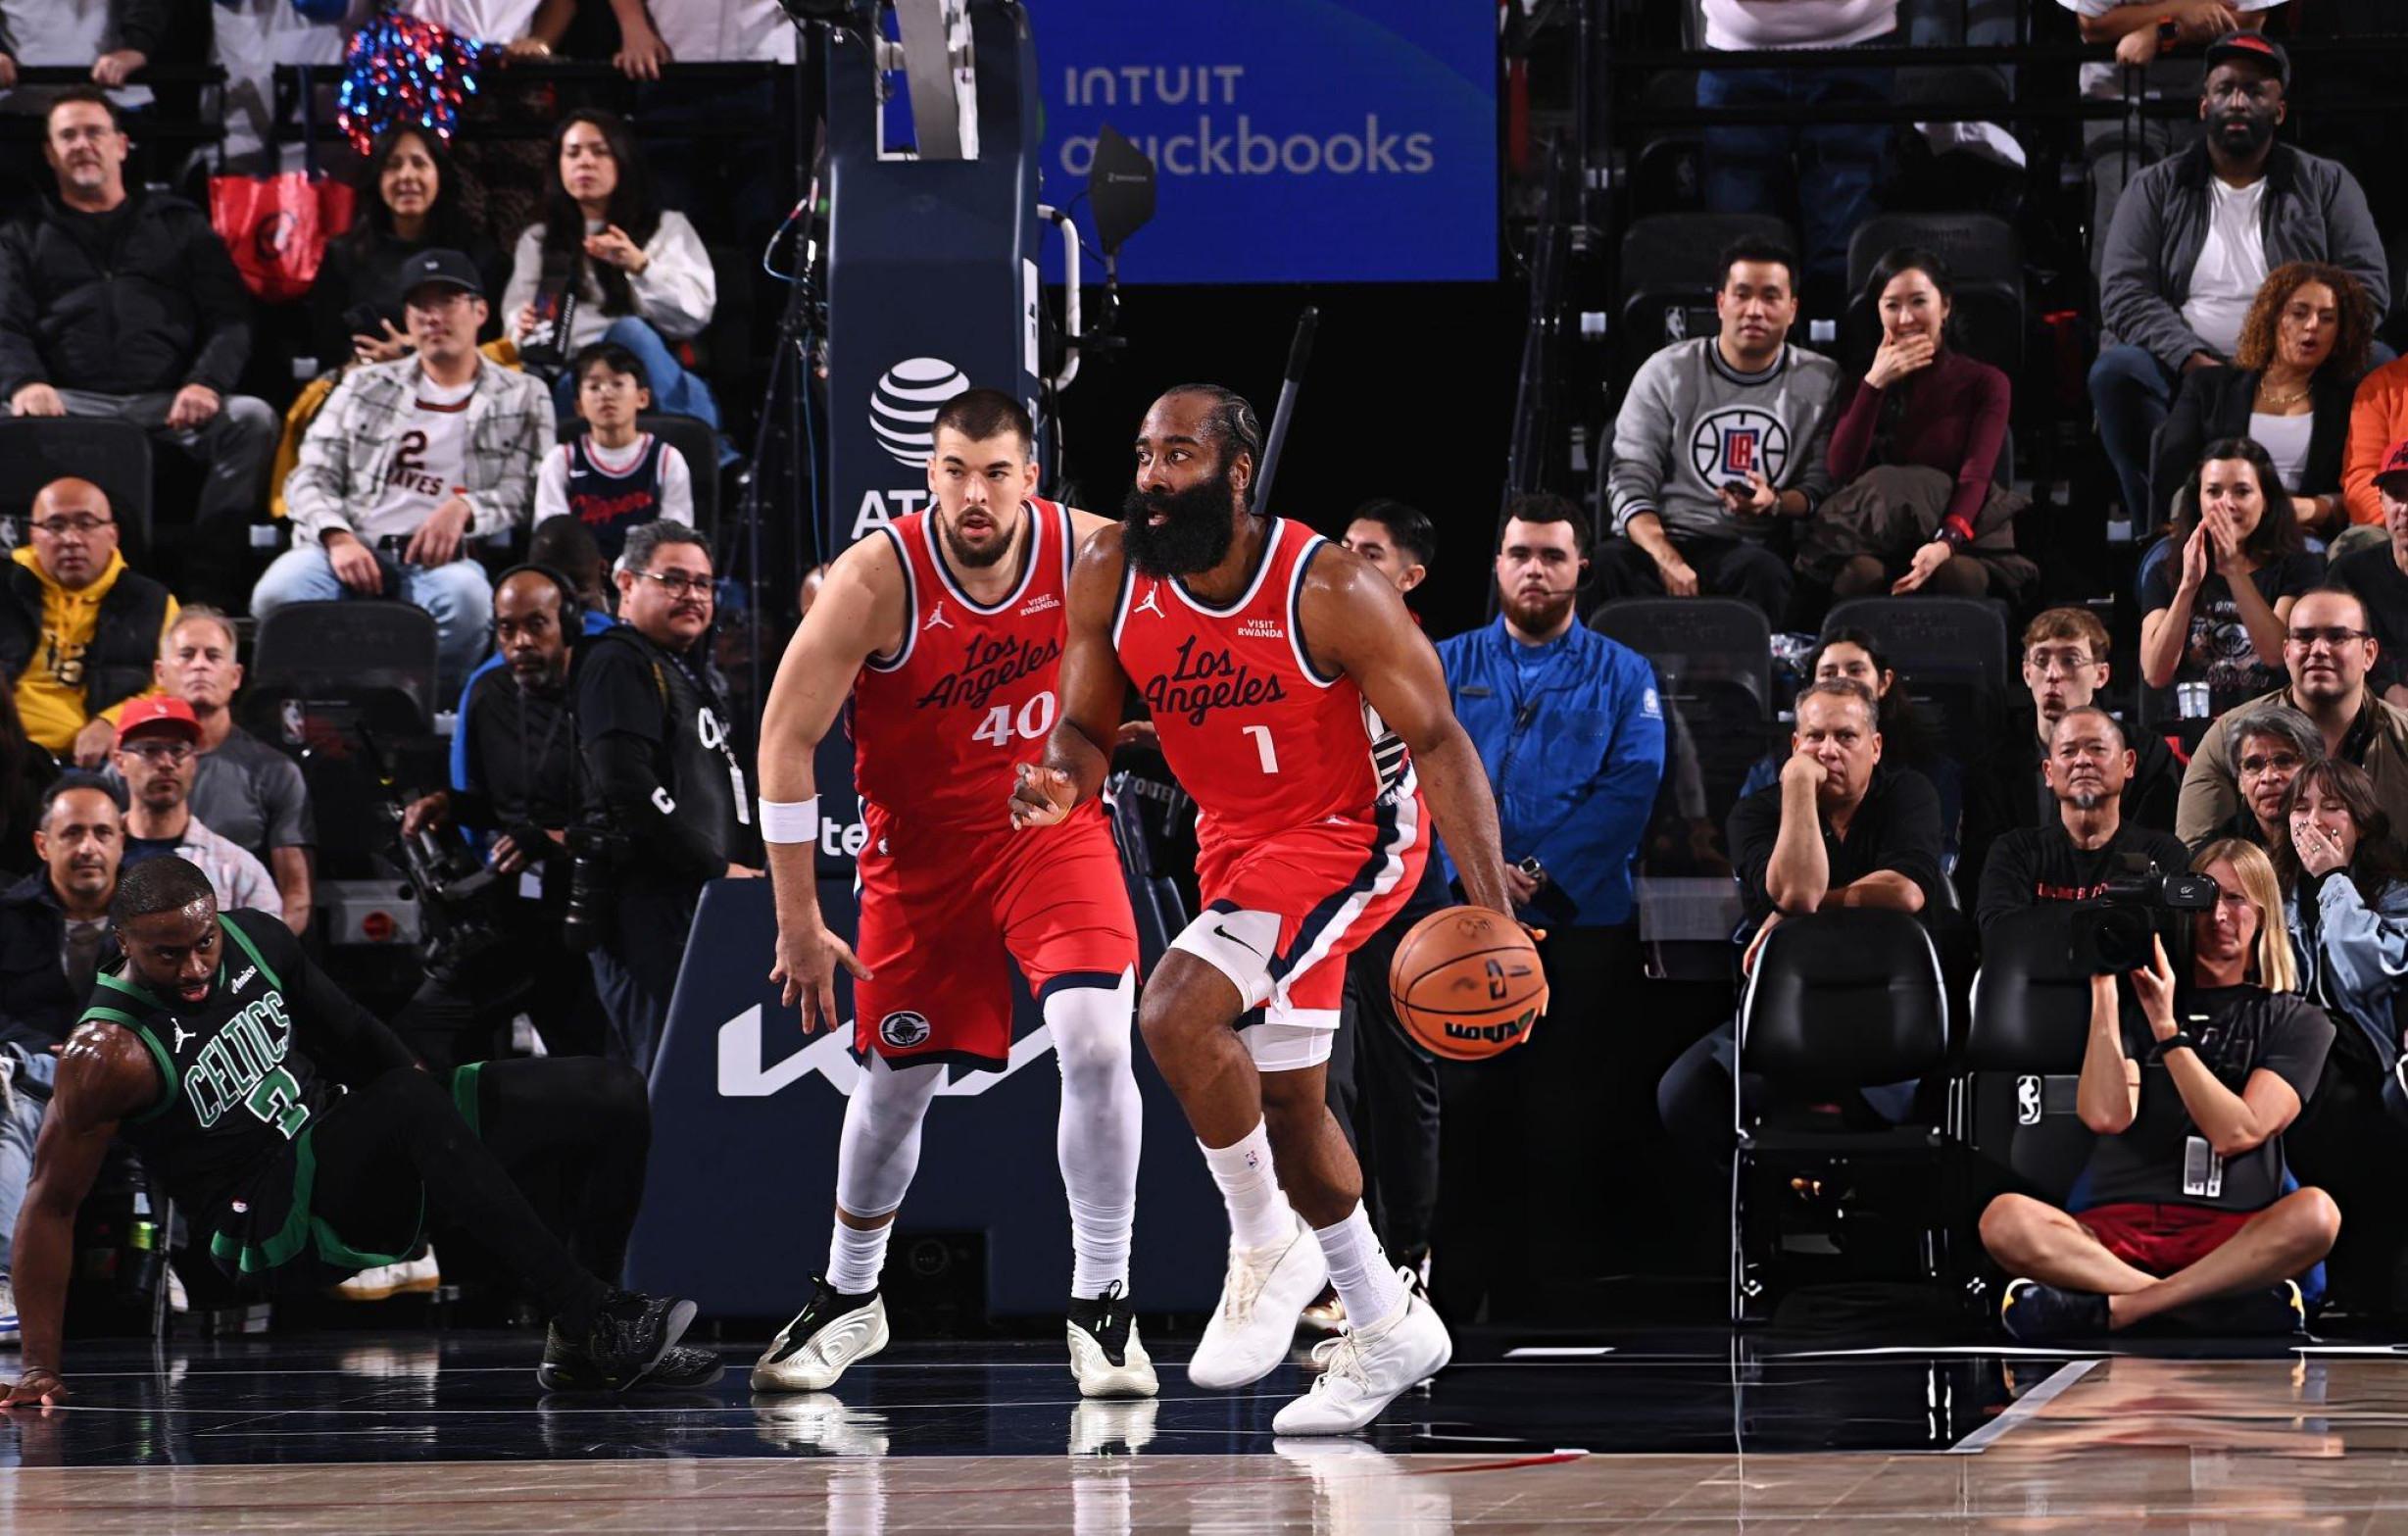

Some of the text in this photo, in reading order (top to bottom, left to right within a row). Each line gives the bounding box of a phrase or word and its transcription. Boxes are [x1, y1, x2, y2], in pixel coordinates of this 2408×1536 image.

[397, 430, 427, 471] 2
[851, 489, 928, 540] AT
[1019, 599, 1060, 617] RWANDA
[1027, 593, 1052, 606] VISIT
[1237, 627, 1284, 638] RWANDA
[1247, 619, 1274, 628] VISIT
[915, 638, 1061, 711] Angeles
[960, 632, 1019, 676] Los
[1171, 634, 1236, 682] Los
[972, 690, 1056, 747] 40
[1145, 665, 1287, 726] Angeles
[1242, 724, 1279, 773] 1
[231, 965, 258, 995] Amica
[184, 990, 291, 1127] CELTICS
